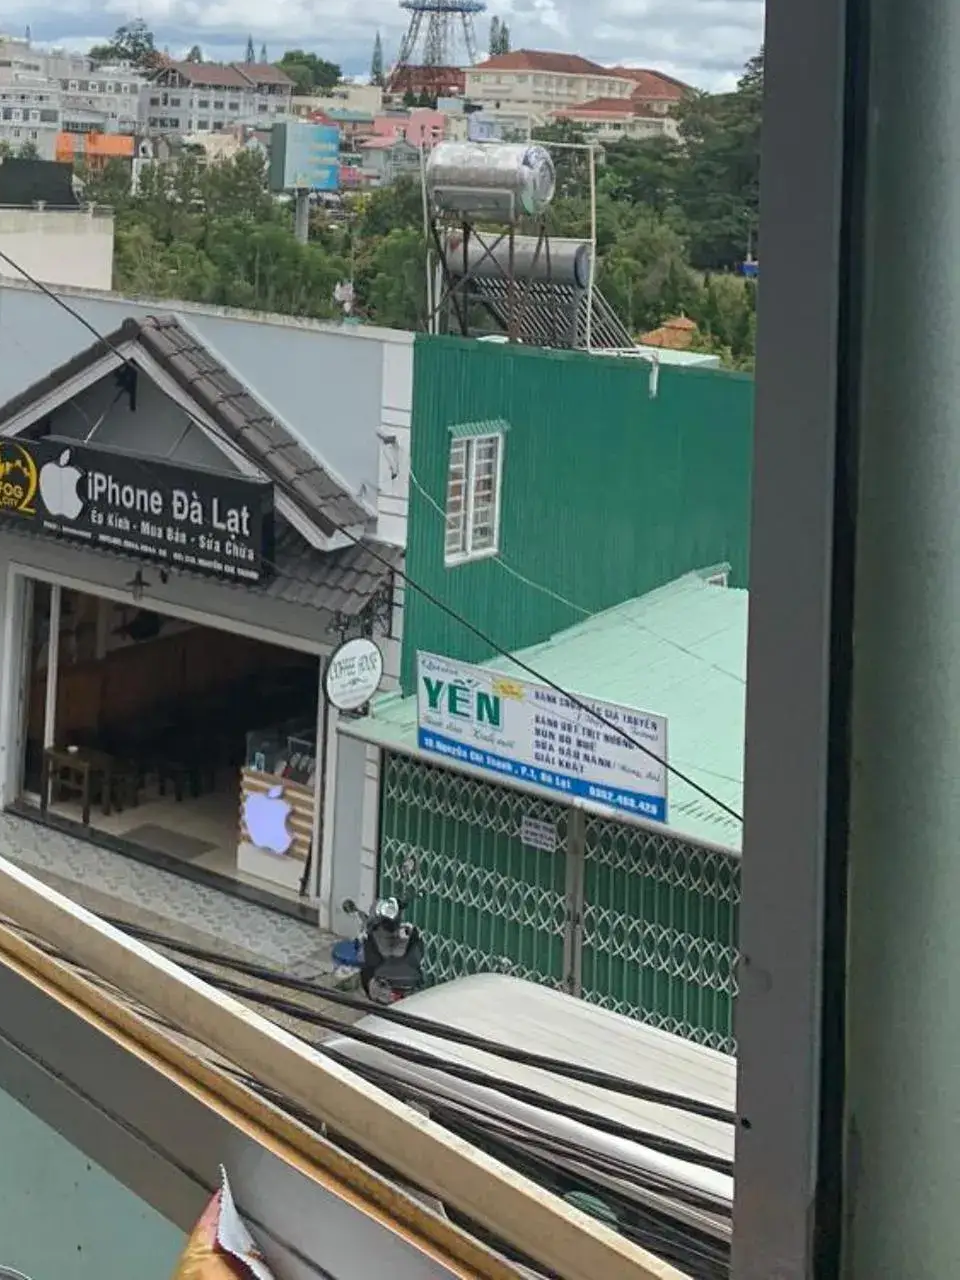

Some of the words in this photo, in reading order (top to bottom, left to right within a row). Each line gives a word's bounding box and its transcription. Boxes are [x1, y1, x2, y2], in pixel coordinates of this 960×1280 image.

[87, 472, 163, 515] iPhone
[172, 489, 203, 525] Đà
[211, 497, 251, 540] Lạt
[422, 676, 500, 726] YẾN
